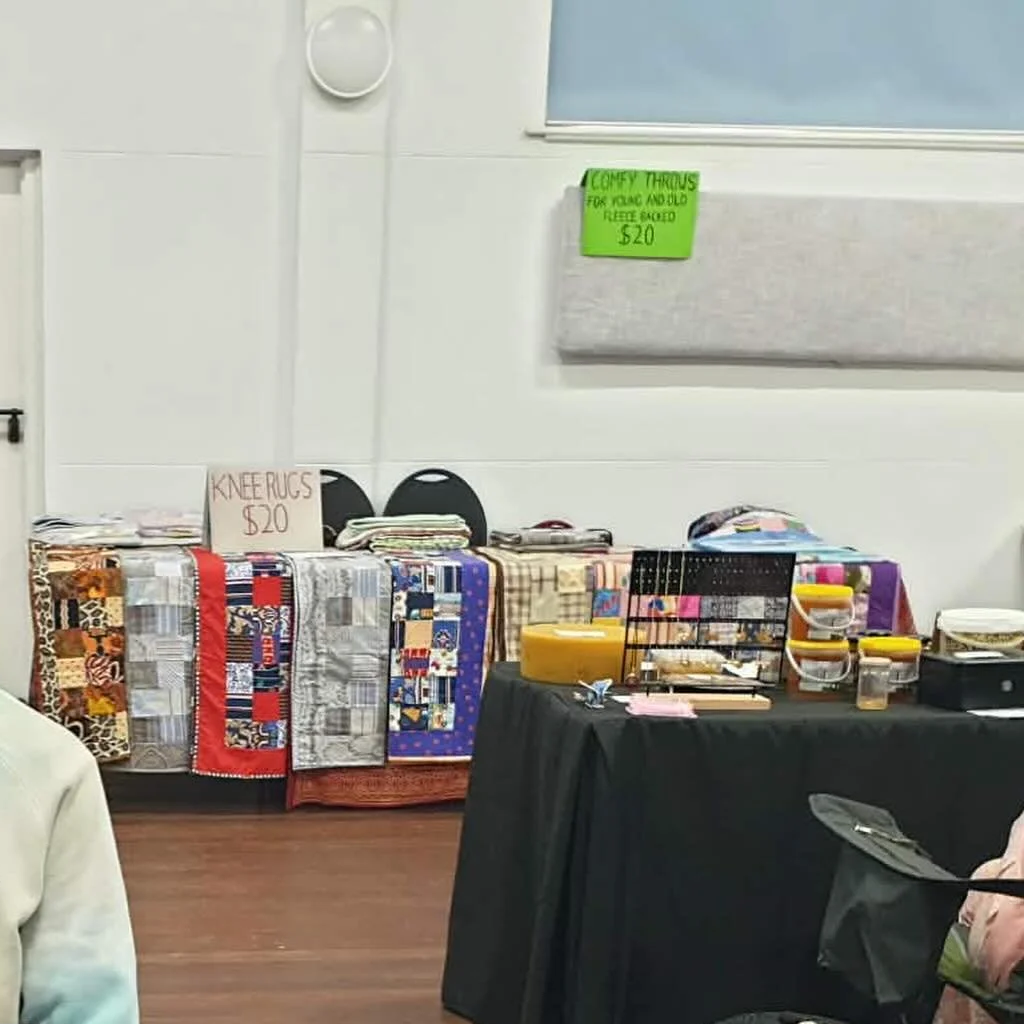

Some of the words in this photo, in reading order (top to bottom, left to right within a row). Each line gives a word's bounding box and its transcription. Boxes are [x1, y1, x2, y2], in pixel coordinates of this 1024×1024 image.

[587, 195, 607, 208] FOR
[612, 194, 643, 207] YOUNG
[646, 194, 665, 207] AND
[667, 193, 688, 207] OLD
[618, 223, 655, 245] $20
[242, 503, 289, 535] $20
